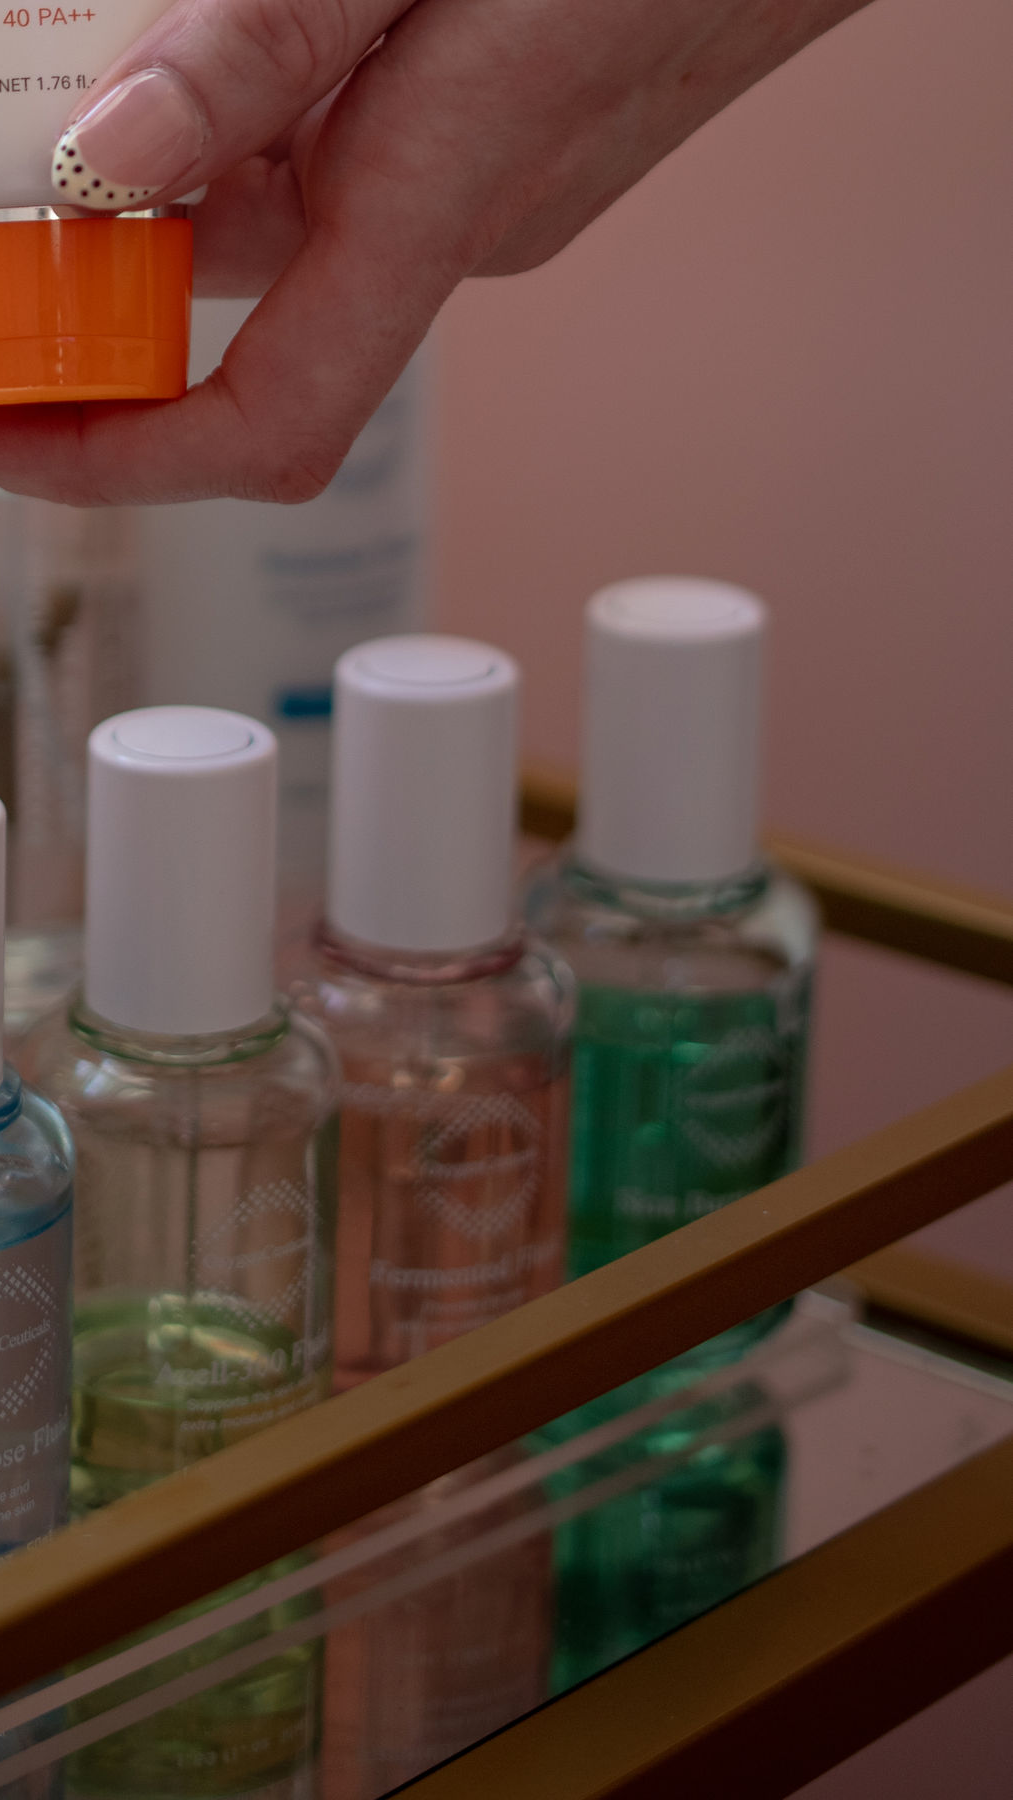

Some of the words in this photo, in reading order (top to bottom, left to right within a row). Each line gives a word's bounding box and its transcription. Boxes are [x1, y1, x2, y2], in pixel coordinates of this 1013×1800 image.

[3, 8, 30, 28] 40
[38, 7, 96, 26] PA++
[36, 76, 71, 91] 1.76
[9, 1480, 31, 1498] and
[14, 1497, 36, 1517] skin
